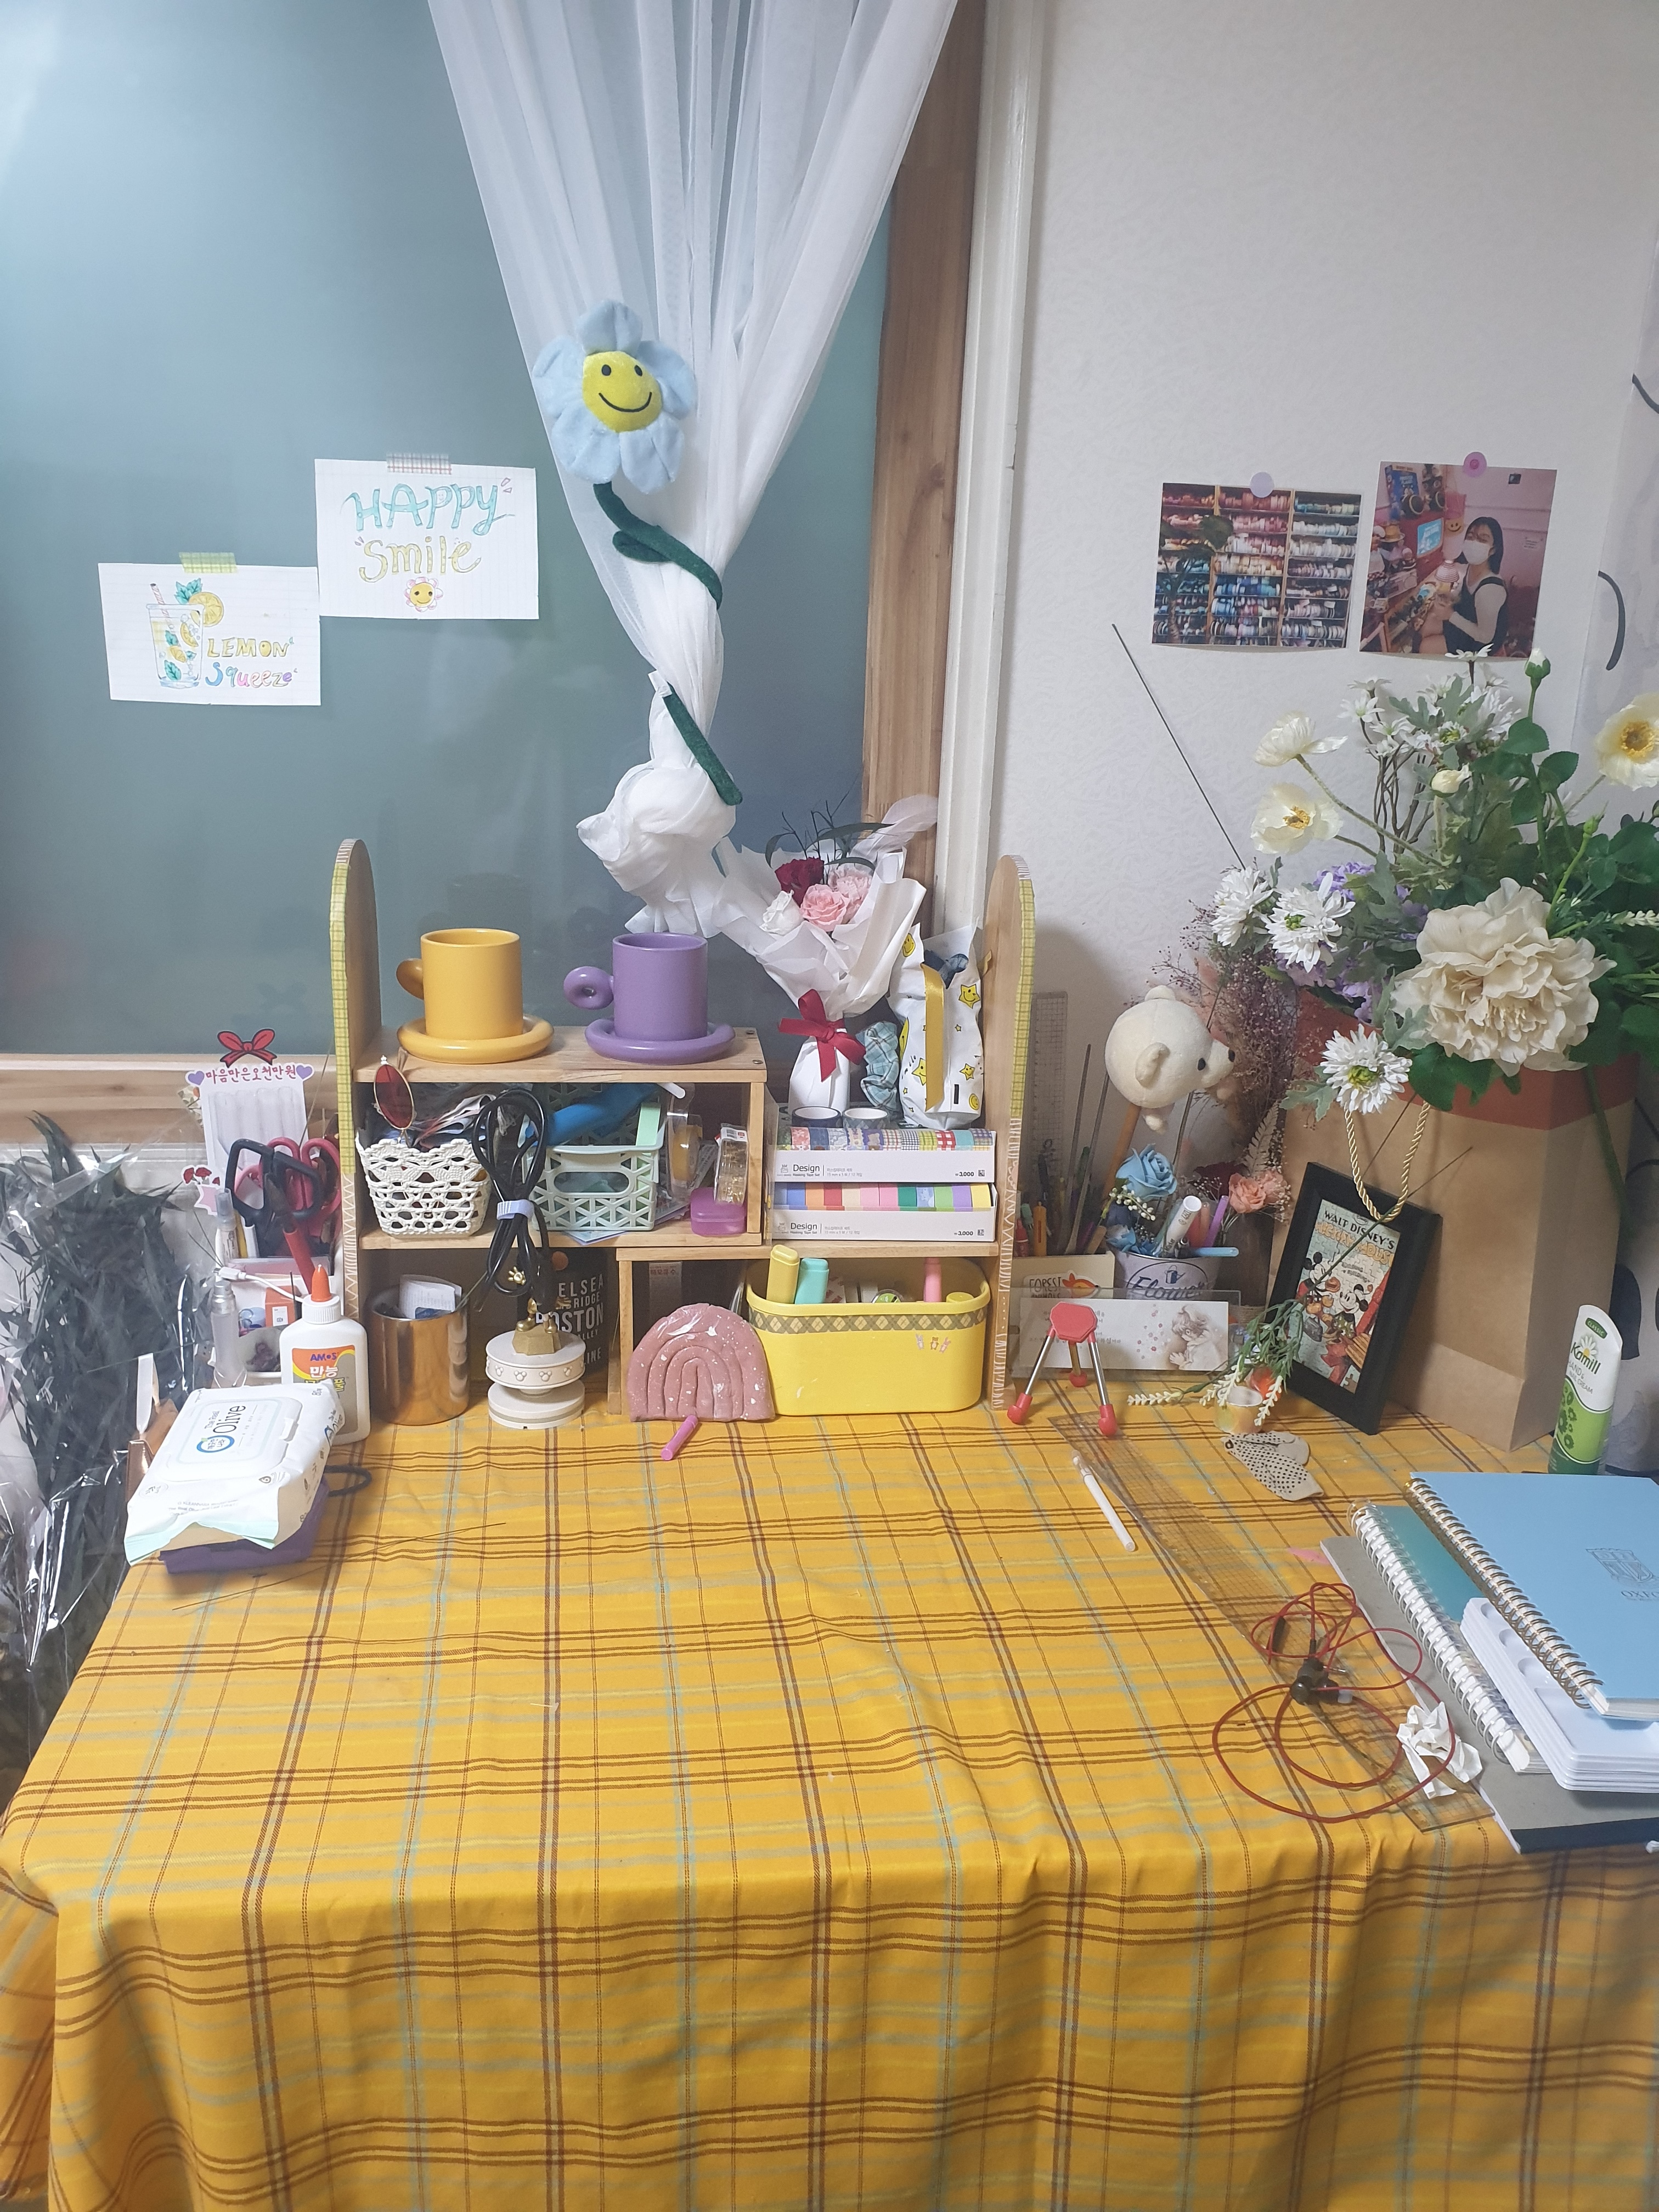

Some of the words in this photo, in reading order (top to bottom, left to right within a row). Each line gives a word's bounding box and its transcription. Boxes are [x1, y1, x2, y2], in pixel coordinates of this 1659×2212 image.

[340, 483, 515, 536] HAPPY
[359, 535, 481, 583] Smile
[207, 637, 290, 658] LEMON
[205, 662, 293, 688] Squeeze
[793, 1164, 820, 1173] Design
[791, 1222, 817, 1231] Design
[1587, 1320, 1605, 1336] CLASSIC
[585, 1347, 601, 1364] INE
[1571, 1342, 1601, 1374] Kamill
[309, 1365, 338, 1378] 만능
[1577, 1378, 1593, 1394] CREAM
[213, 1406, 246, 1433] Olive
